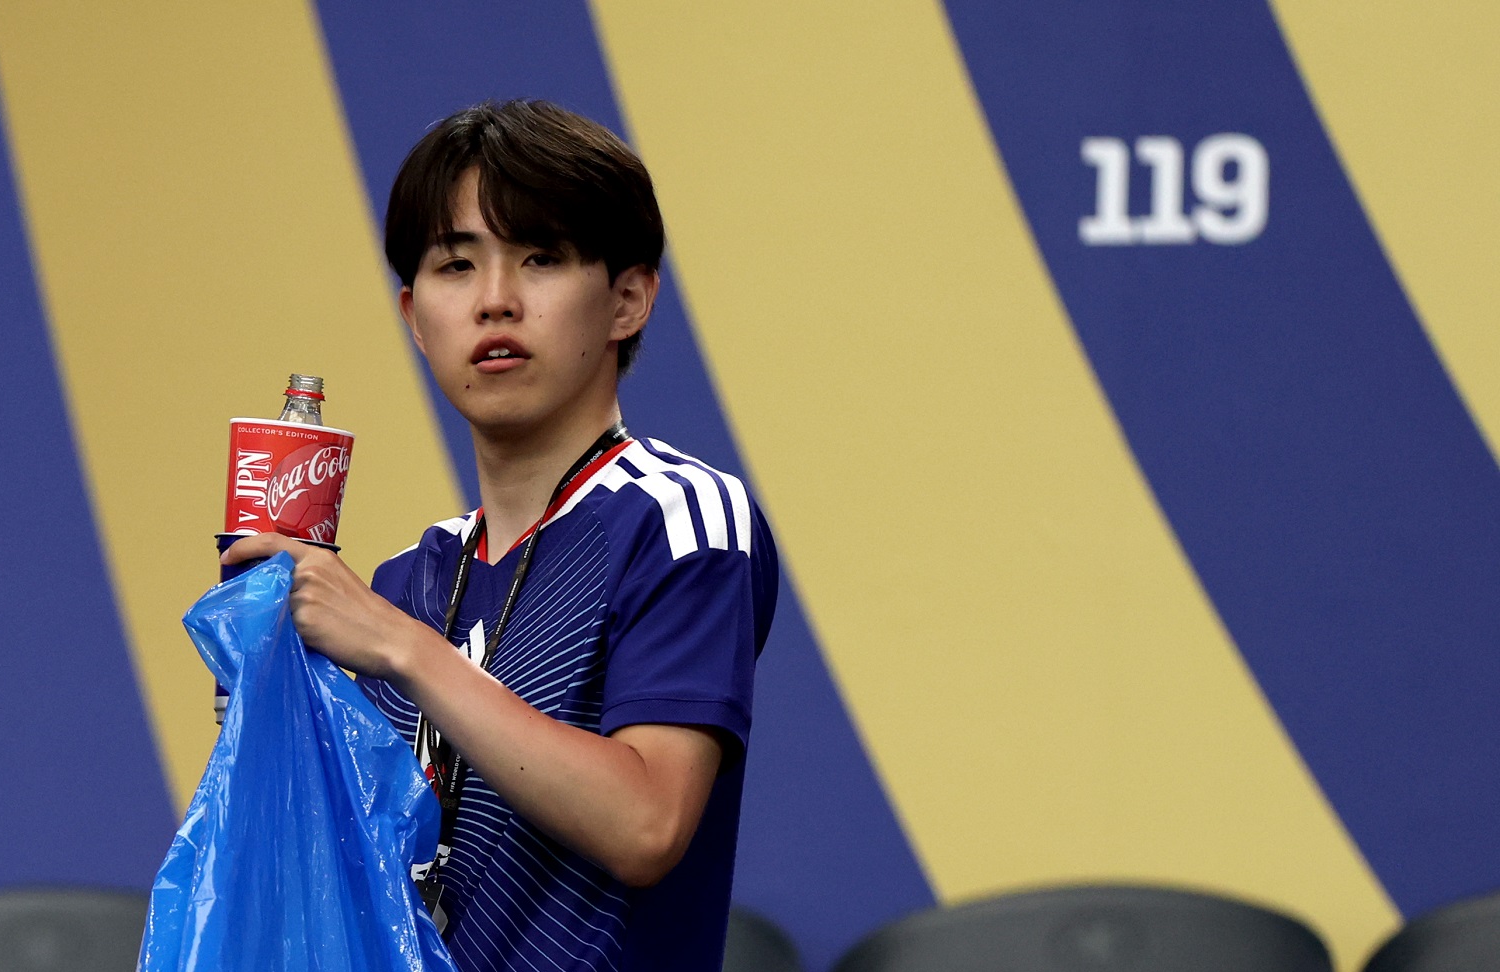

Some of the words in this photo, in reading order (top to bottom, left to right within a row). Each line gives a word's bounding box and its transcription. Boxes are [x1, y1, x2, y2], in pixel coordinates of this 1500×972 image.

[1078, 132, 1270, 246] 119
[238, 426, 283, 436] COLLECTOR'S
[285, 430, 319, 441] EDITION
[235, 448, 272, 508] JPN
[267, 446, 349, 521] Coca-Cola
[452, 763, 460, 781] WORLD
